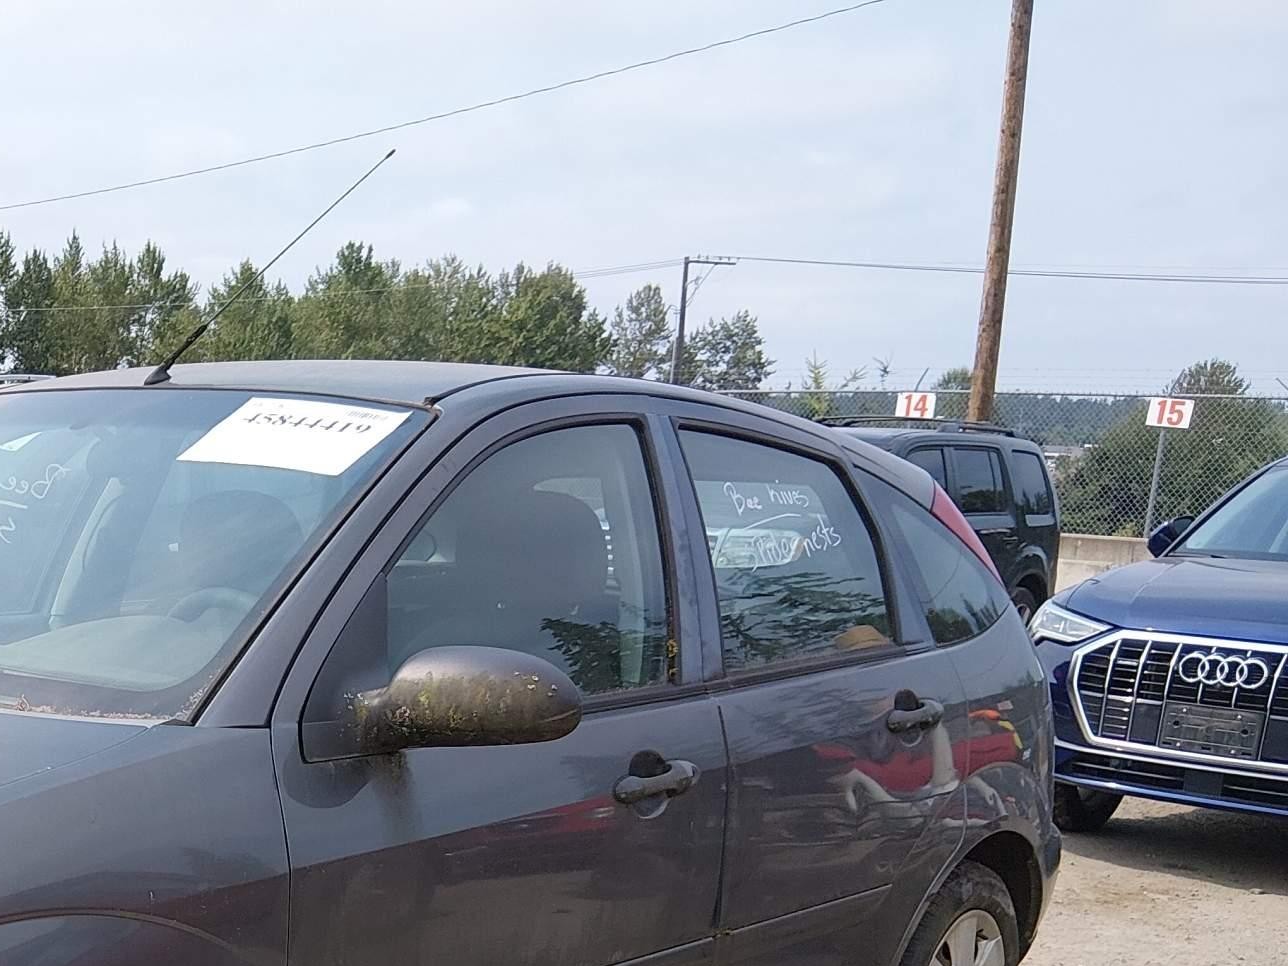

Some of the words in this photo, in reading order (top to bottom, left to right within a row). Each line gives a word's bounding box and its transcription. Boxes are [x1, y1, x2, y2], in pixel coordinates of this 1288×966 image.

[904, 394, 929, 418] 14
[1157, 400, 1184, 426] 15
[242, 412, 372, 433] 45844419
[723, 481, 762, 516] Bee
